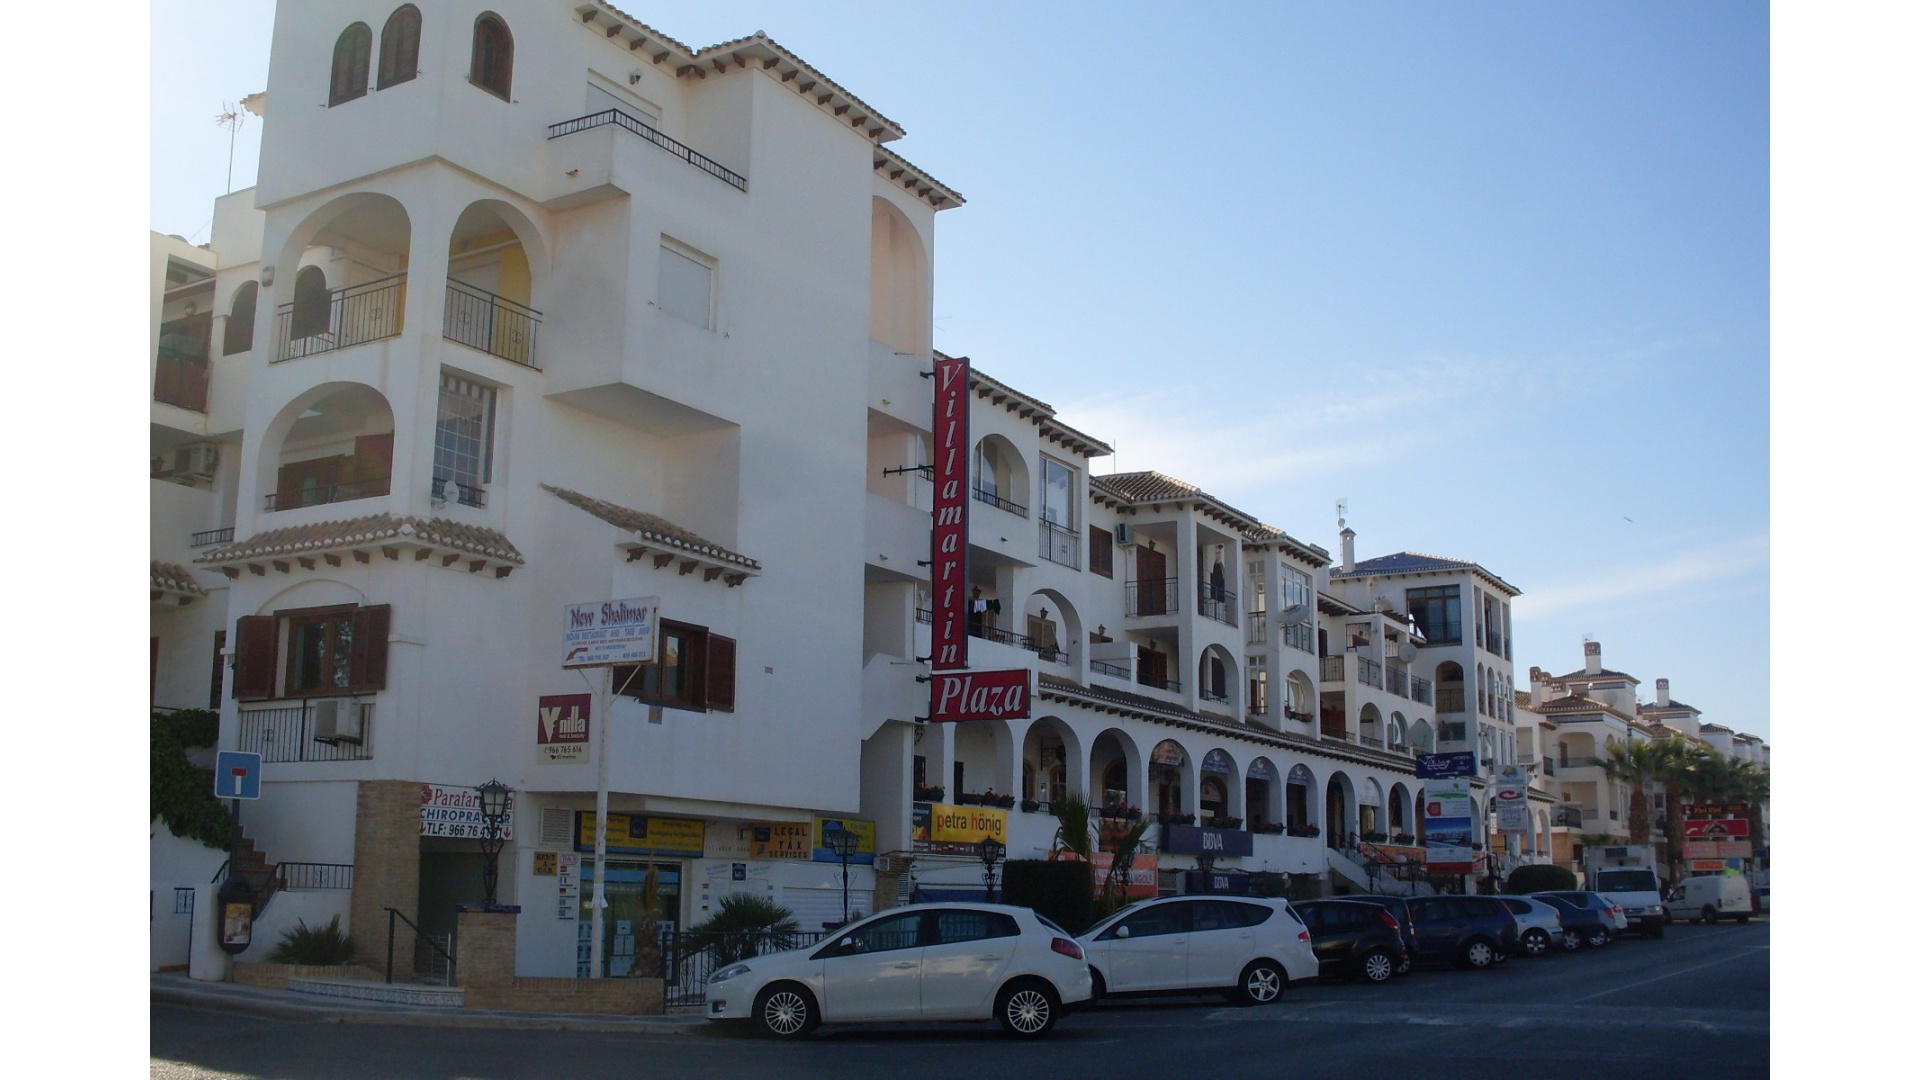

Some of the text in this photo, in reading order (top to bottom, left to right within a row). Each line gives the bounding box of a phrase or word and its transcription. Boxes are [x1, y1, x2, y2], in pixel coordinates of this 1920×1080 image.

[938, 363, 963, 664] Villamartin
[570, 602, 647, 629] New Shalimar
[936, 676, 1024, 717] Plaza
[549, 746, 559, 754] 966
[561, 745, 571, 753] 765
[427, 822, 447, 835] TLF:
[449, 824, 465, 836] 966
[467, 825, 478, 837] 76
[937, 812, 1002, 836] petra hönig
[774, 827, 807, 837] LEGAL
[778, 840, 801, 849] TAX
[1203, 832, 1223, 850] BBVA
[769, 851, 808, 859] SERVICES
[1214, 876, 1229, 889] BBVA
